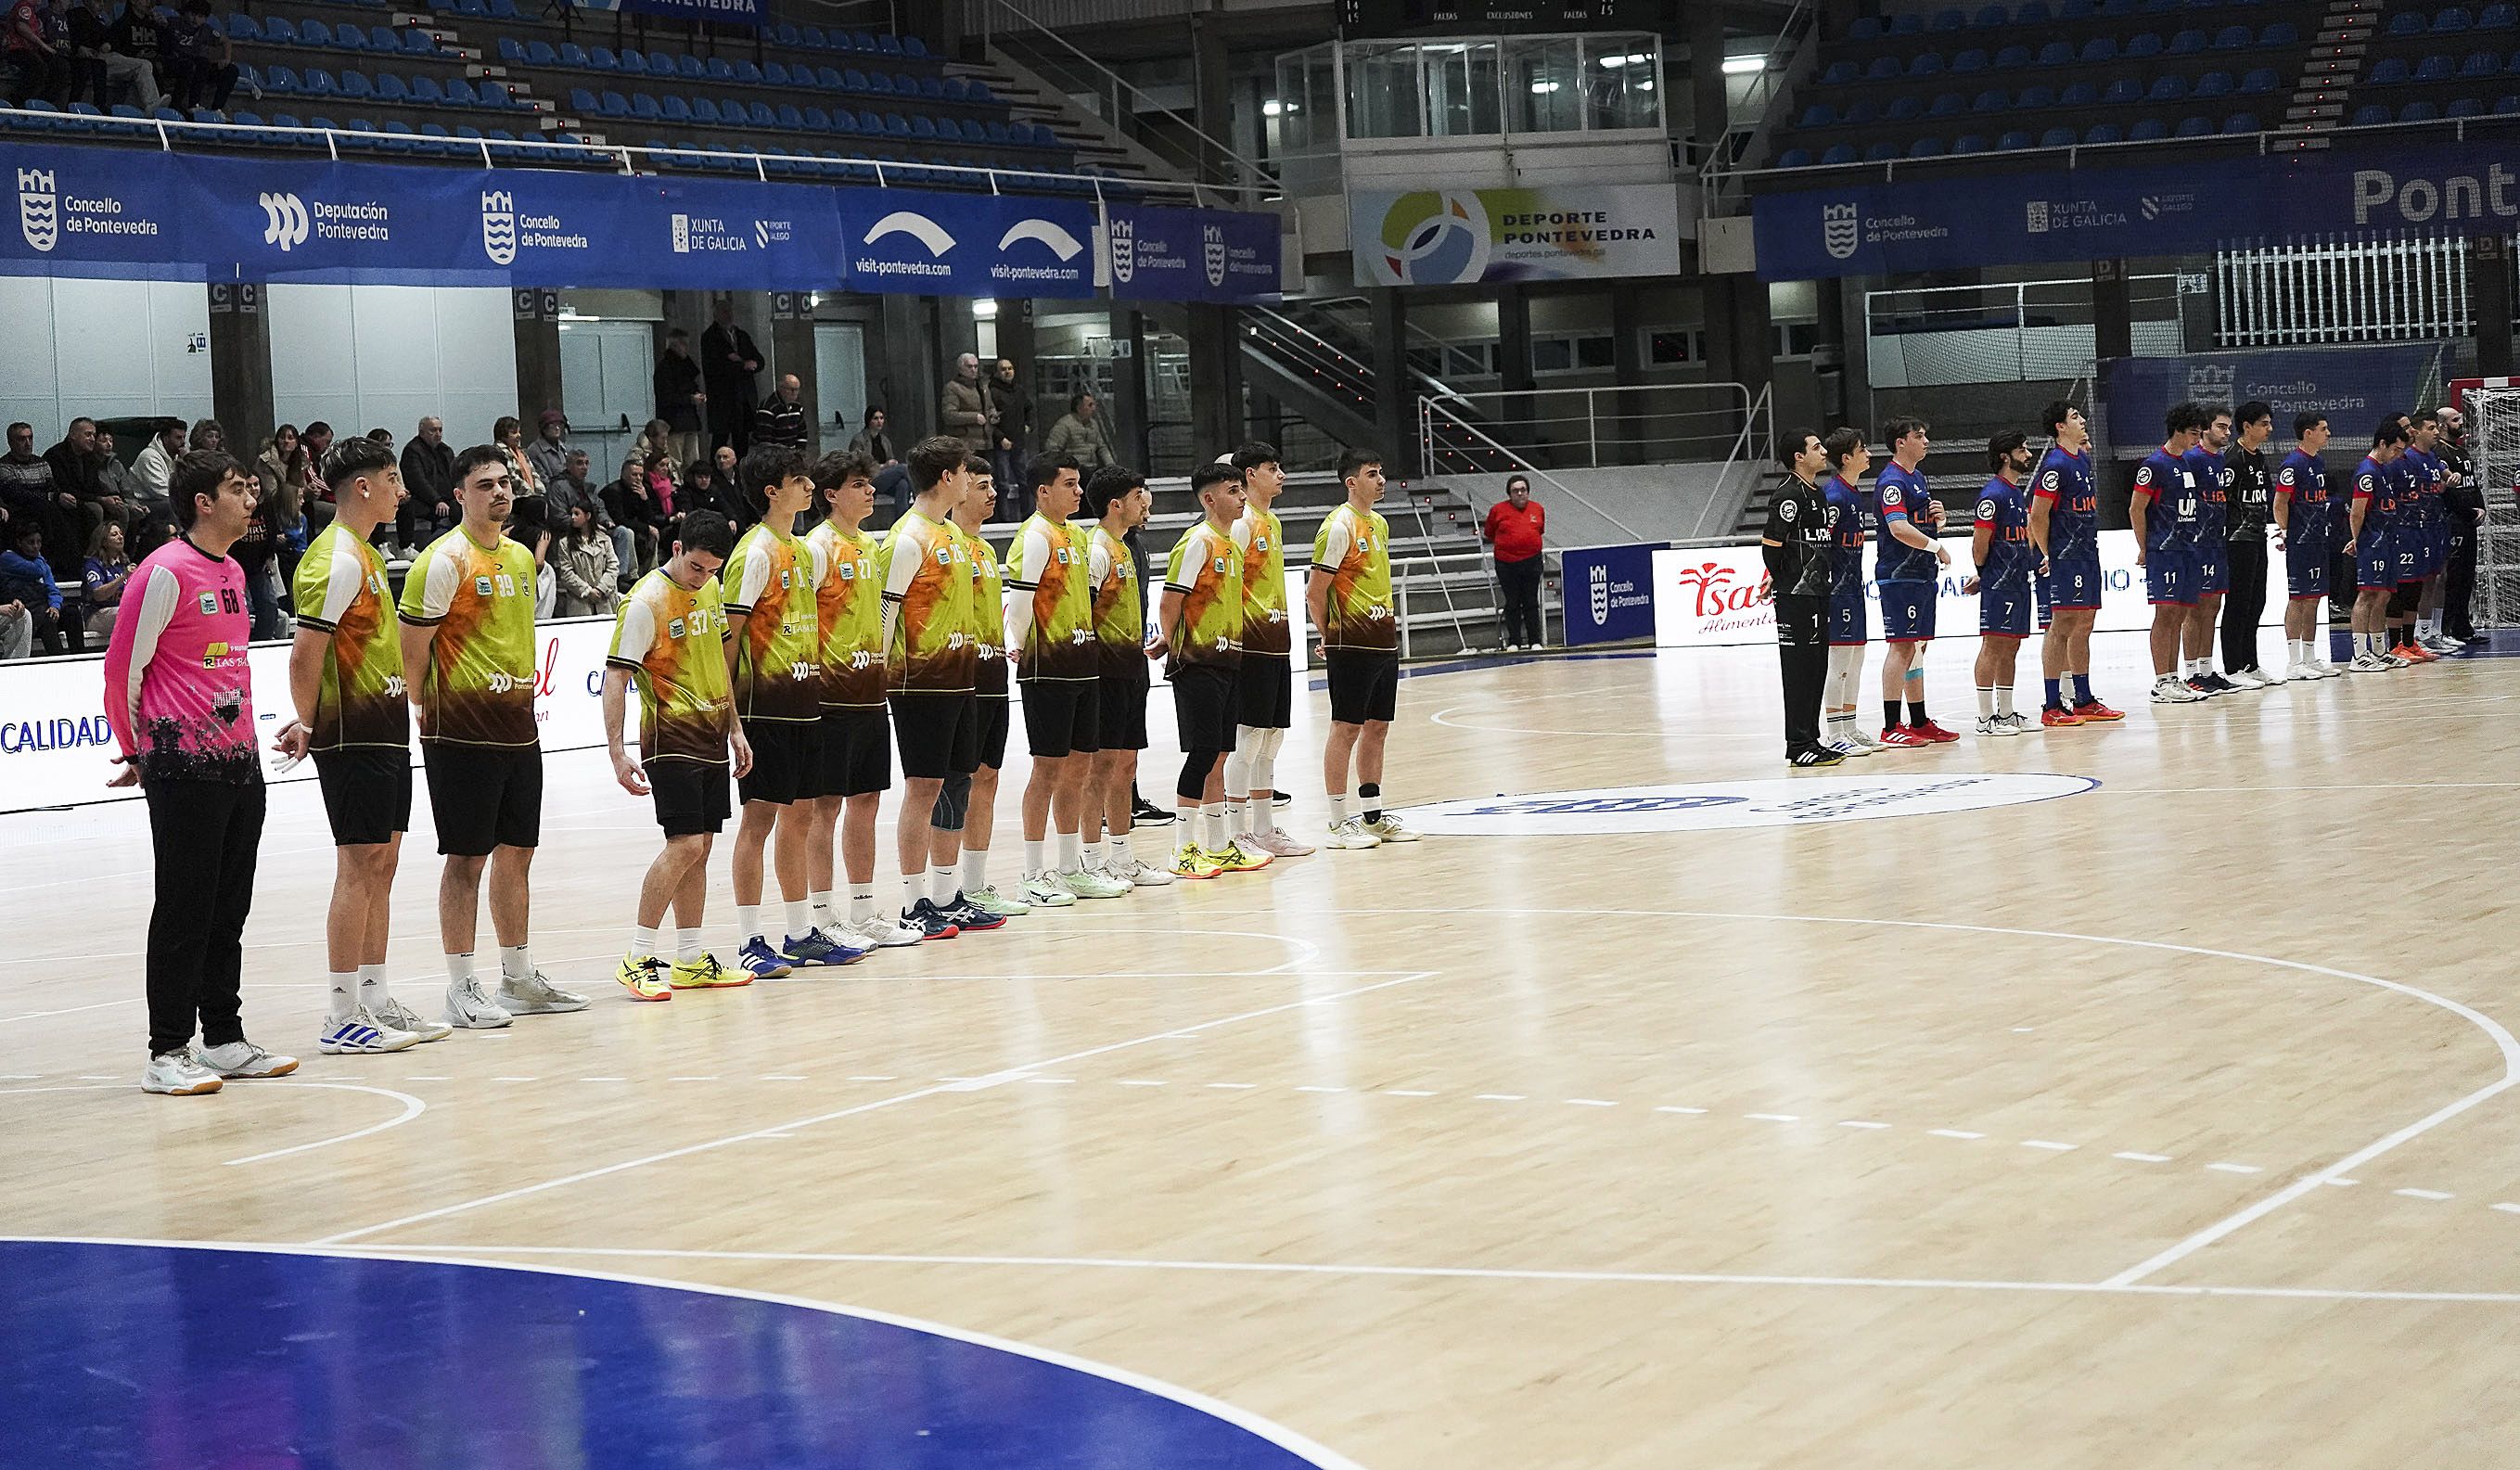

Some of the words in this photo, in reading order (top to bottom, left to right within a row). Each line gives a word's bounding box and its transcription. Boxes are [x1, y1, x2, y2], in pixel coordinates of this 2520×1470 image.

[1433, 12, 1458, 20] FALTAS
[1563, 10, 1587, 19] FALTAS
[58, 19, 69, 32] 24
[179, 35, 194, 45] 22
[65, 196, 122, 214] Concello
[313, 200, 388, 223] Deputación
[2053, 200, 2098, 215] XUNTA
[67, 217, 83, 232] de
[84, 217, 158, 236] Pontevedra
[519, 214, 560, 230] Concello
[691, 218, 725, 233] XUNTA
[1503, 211, 1607, 226] DEPORTE
[1865, 215, 1916, 229] Concello
[2053, 216, 2069, 229] DE
[2073, 213, 2128, 228] GALICIA
[317, 222, 389, 241] Pontevedra
[1504, 228, 1657, 245] PONTEVEDRA
[1866, 231, 1882, 243] de
[1882, 226, 1949, 242] Pontevedra
[521, 232, 534, 247] de
[534, 233, 588, 249] Pontevedra
[691, 236, 705, 249] DE
[707, 236, 747, 250] GALICIA
[1137, 239, 1168, 253] Concello
[856, 258, 952, 277] visit-pontevedra.com
[1137, 256, 1147, 268] de
[1147, 255, 1186, 269] Pontevedra
[991, 263, 1079, 282] visit-pontevedra.com
[212, 284, 228, 302] C
[242, 284, 254, 302] C
[518, 292, 532, 310] C
[544, 295, 556, 313] C
[776, 294, 790, 311] C
[801, 295, 812, 312] C
[2245, 380, 2317, 397] Concello
[2271, 395, 2365, 414] Pontevedra
[2216, 472, 2225, 487] 14
[2430, 468, 2441, 481] 33
[2450, 536, 2463, 547] 47
[950, 543, 966, 563] 26
[1068, 546, 1081, 565] 15
[2399, 554, 2414, 565] 22
[857, 558, 871, 579] 27
[981, 559, 995, 579] 19
[2202, 564, 2215, 577] 14
[2372, 560, 2385, 571] 19
[2074, 574, 2083, 588] 8
[2164, 571, 2177, 584] 11
[2309, 568, 2321, 580] 17
[221, 588, 240, 614] 68
[1610, 596, 1618, 608] de
[2004, 602, 2014, 615] 7
[1842, 608, 1851, 622] 5
[1907, 605, 1917, 620] 6
[688, 609, 709, 636] 37
[1811, 613, 1819, 629] 1
[1, 715, 112, 754] CALIDAD
